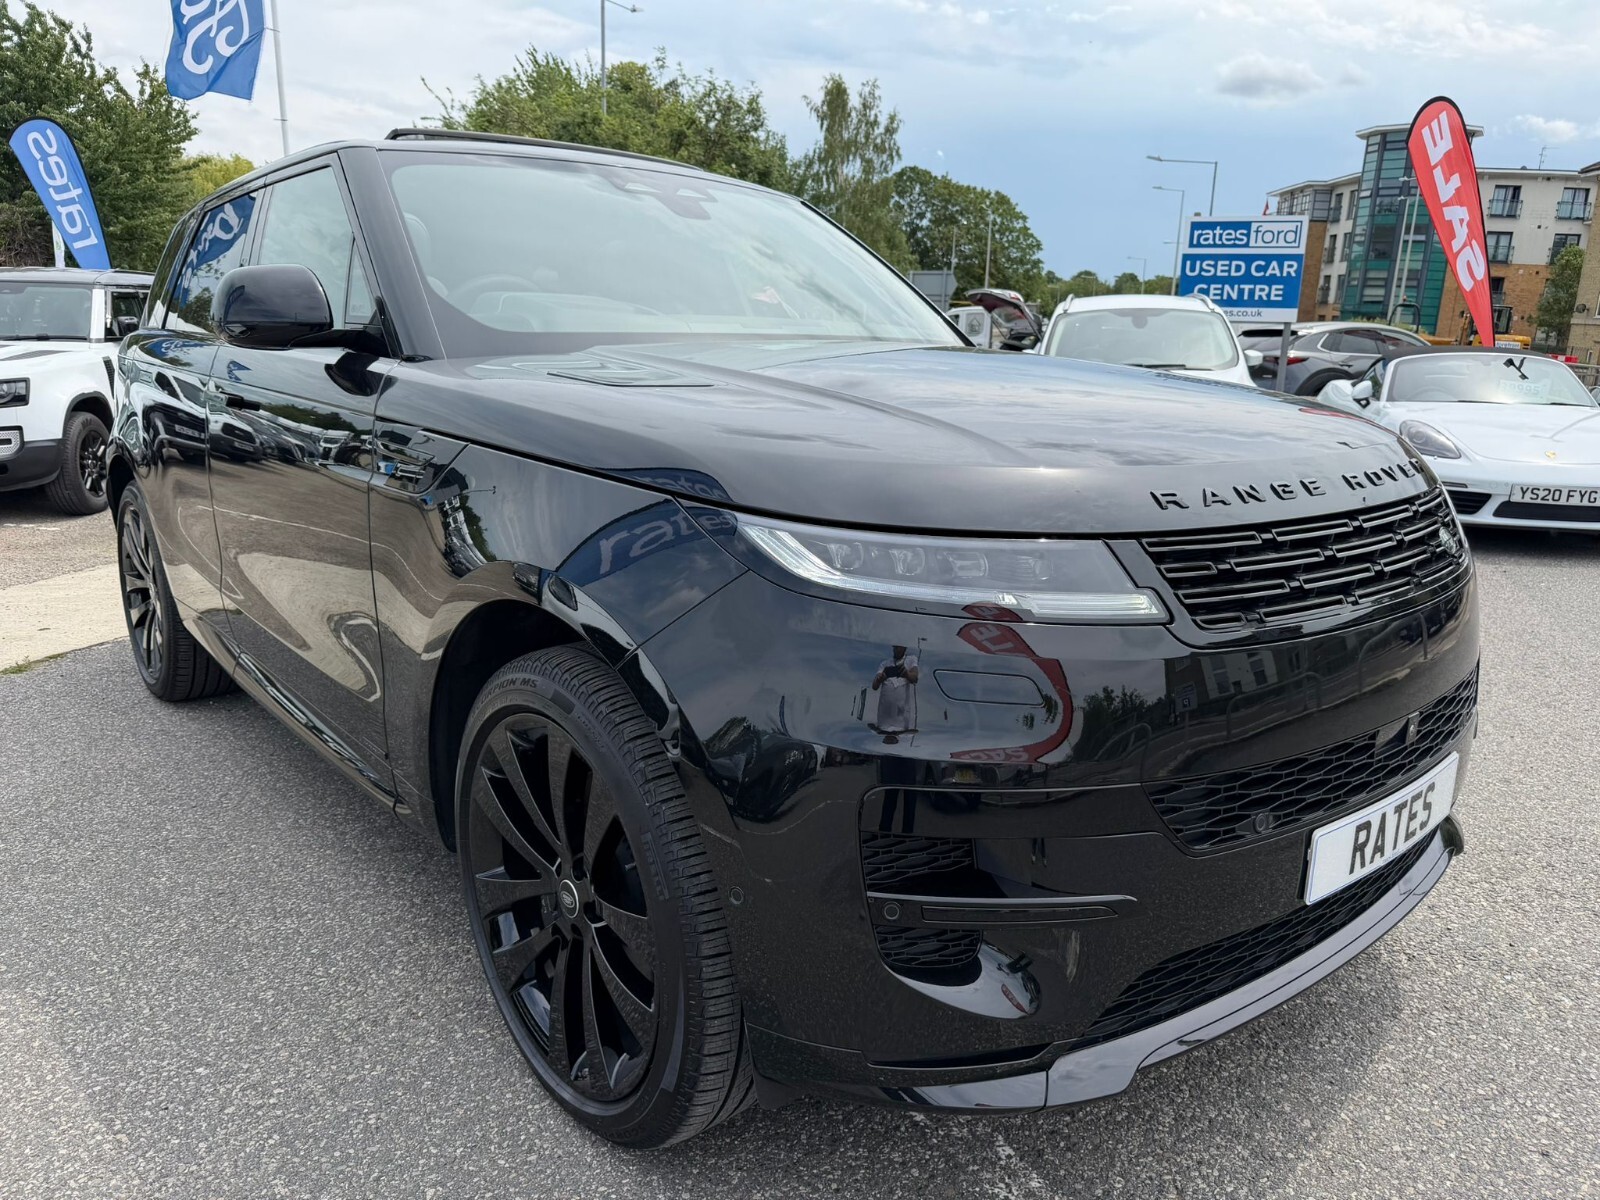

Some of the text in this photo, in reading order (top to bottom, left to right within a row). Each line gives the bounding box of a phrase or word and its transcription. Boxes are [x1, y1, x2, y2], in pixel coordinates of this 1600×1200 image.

[1192, 225, 1299, 245] rates ford
[1185, 260, 1298, 277] USED CAR
[1193, 283, 1284, 301] CENTRE
[1150, 457, 1424, 510] RANGE ROVER
[1520, 486, 1599, 504] YS20 FYG
[1348, 781, 1436, 875] RATES
